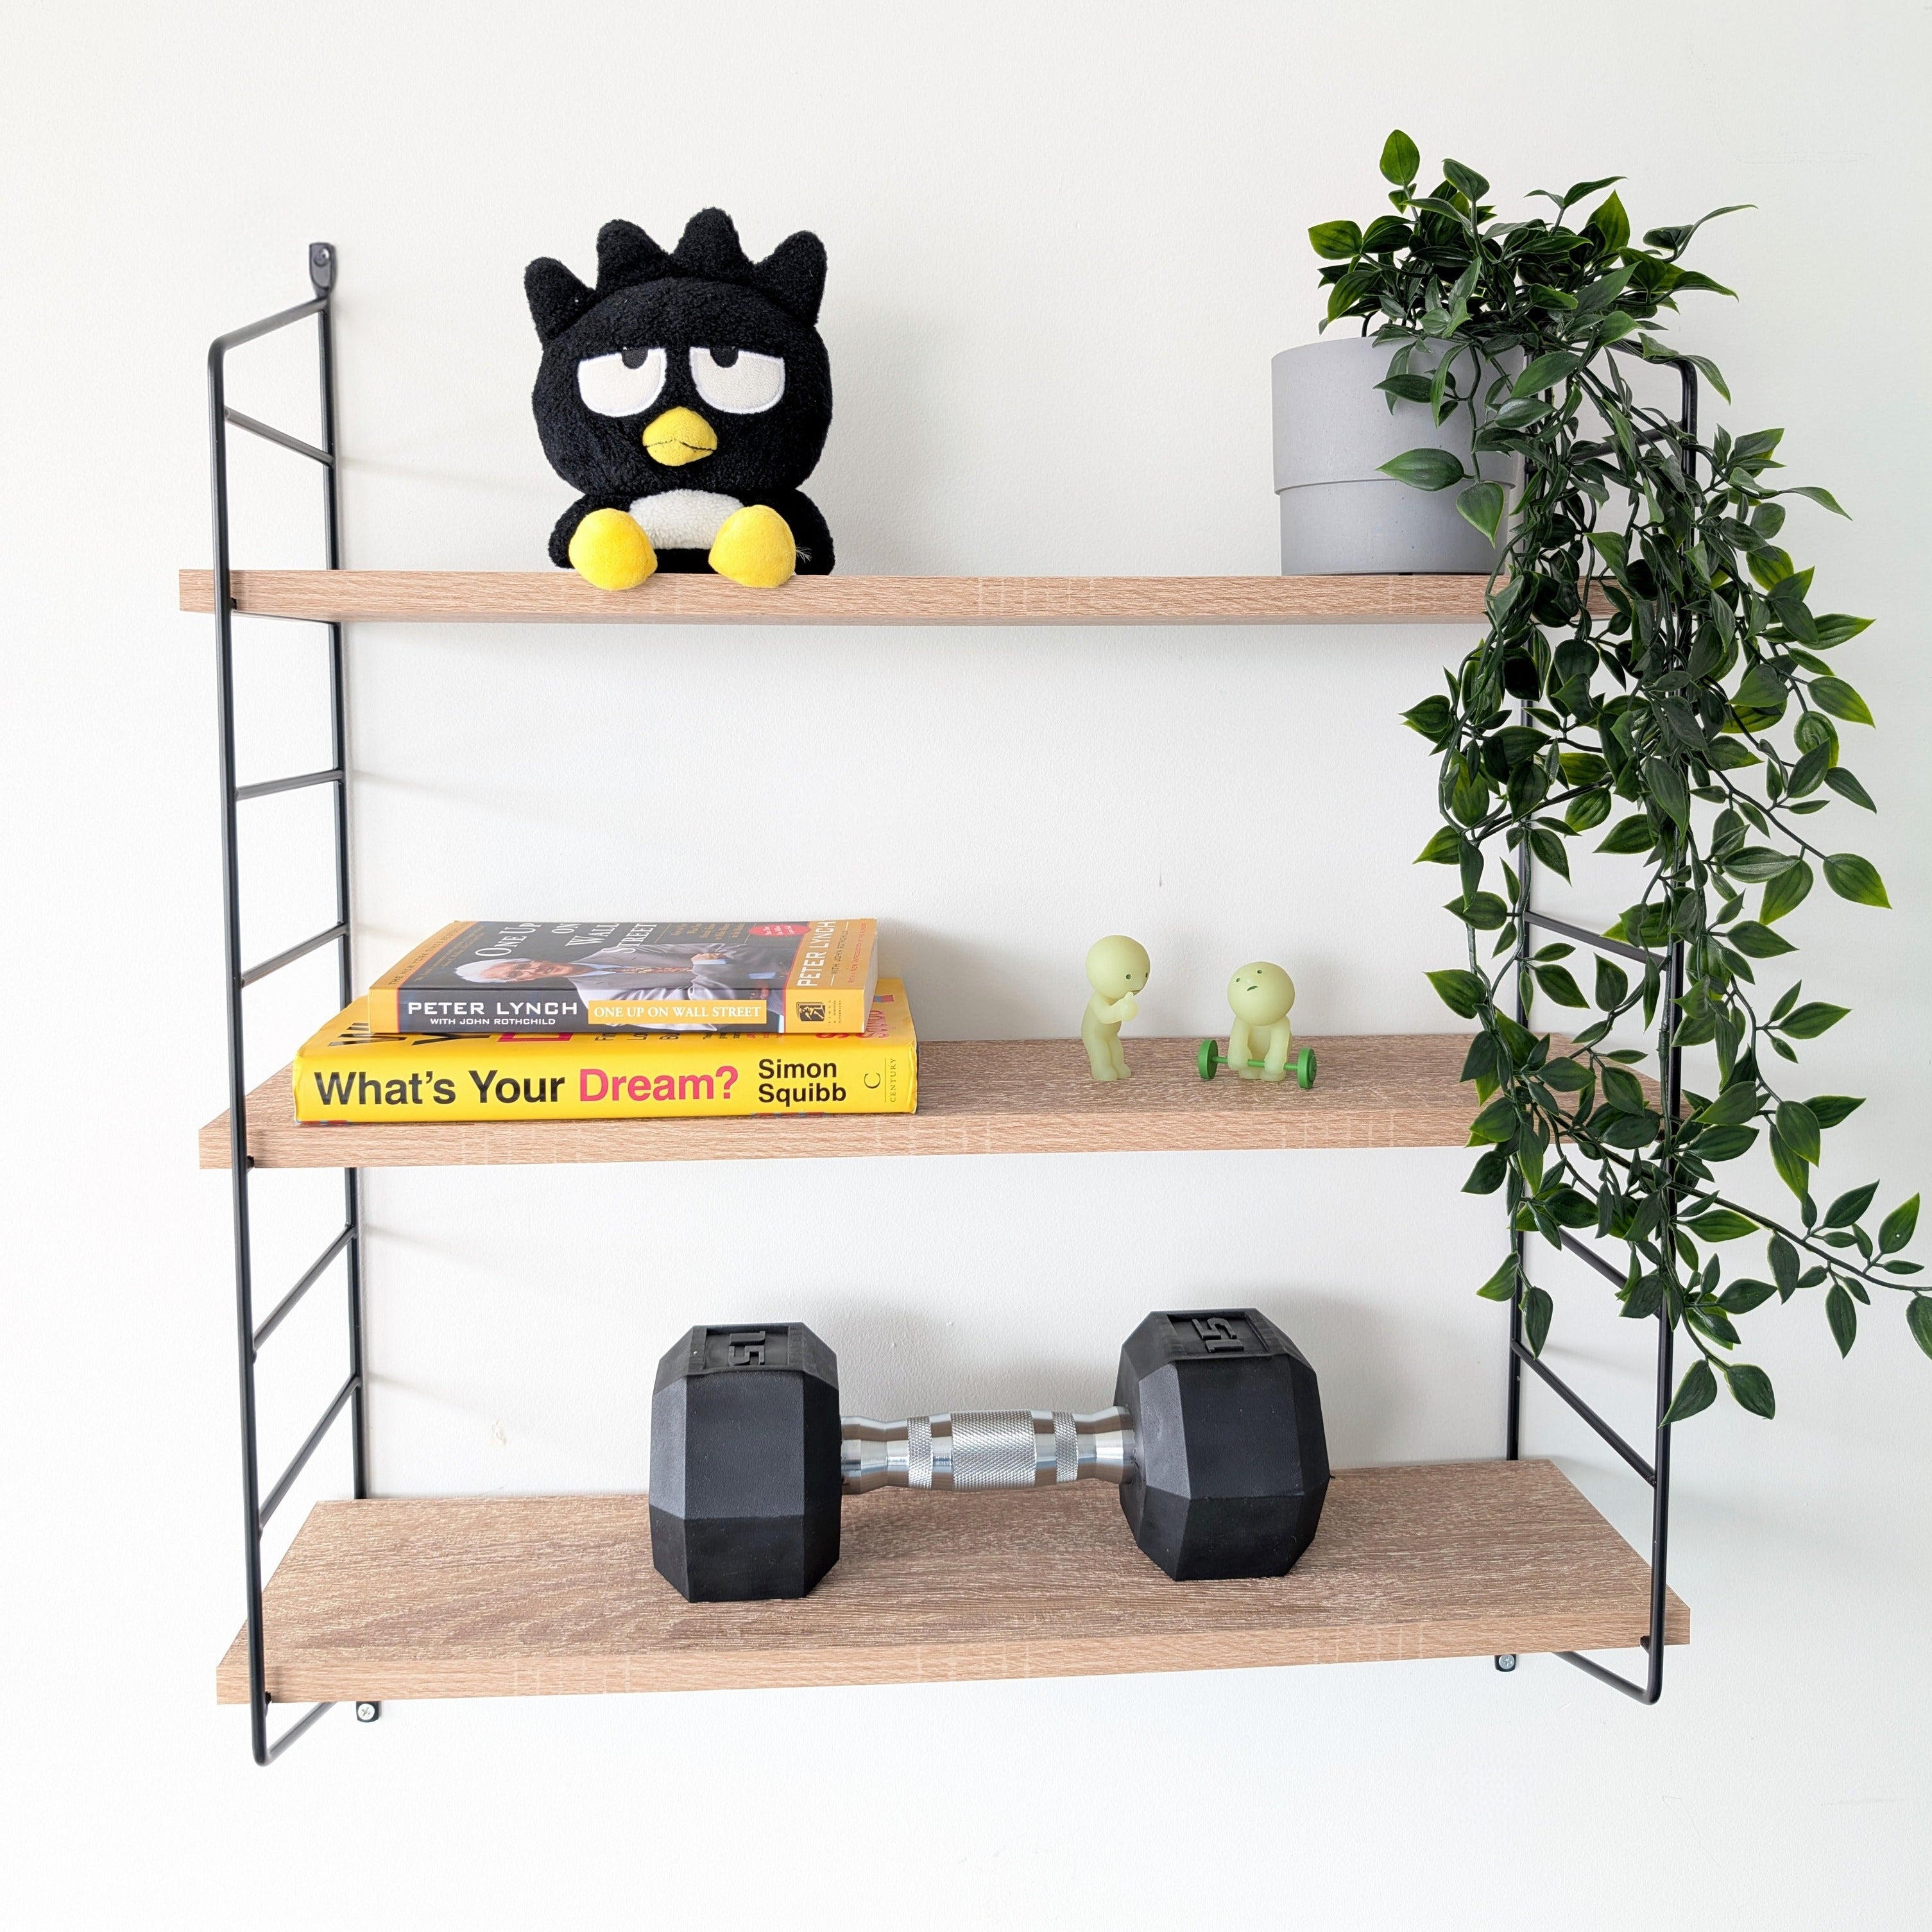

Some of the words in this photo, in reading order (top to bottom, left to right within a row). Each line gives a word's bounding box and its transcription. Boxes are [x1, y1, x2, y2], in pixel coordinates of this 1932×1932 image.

[499, 923, 542, 934] UP
[551, 923, 582, 934] ON
[565, 923, 620, 946] WALL
[601, 923, 658, 954] STREET
[808, 921, 837, 948] LYNCH
[475, 936, 527, 957] ONE
[796, 952, 827, 986] PETER
[407, 1002, 485, 1015] PETER
[496, 1002, 577, 1015] LYNCH
[594, 1007, 623, 1018] ONE
[627, 1007, 644, 1018] UP
[647, 1007, 669, 1018] ON
[672, 1006, 710, 1018] WALL
[712, 1006, 762, 1018] STREET
[758, 1058, 837, 1079] Simon
[863, 1072, 882, 1089] C
[889, 1057, 898, 1103] CENTURY
[313, 1070, 457, 1106] What’s
[468, 1069, 565, 1104] Your
[579, 1065, 739, 1102] Dream?
[758, 1082, 847, 1107] Squibb
[1192, 1317, 1245, 1353] 15
[728, 1330, 766, 1366] 15
